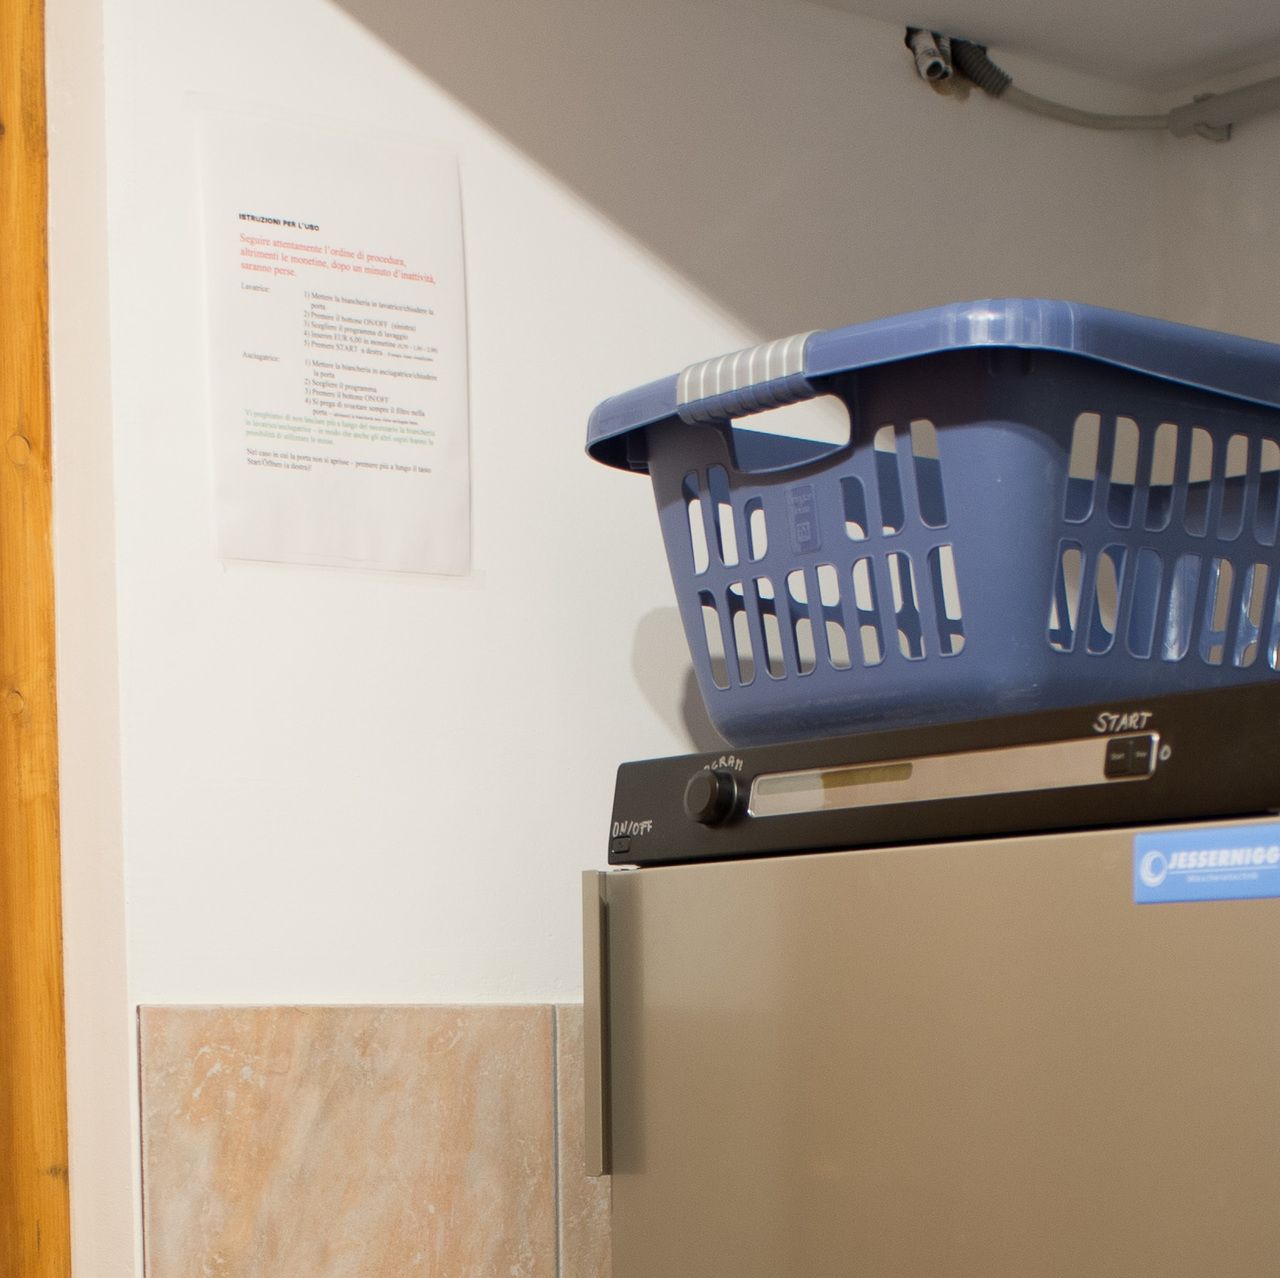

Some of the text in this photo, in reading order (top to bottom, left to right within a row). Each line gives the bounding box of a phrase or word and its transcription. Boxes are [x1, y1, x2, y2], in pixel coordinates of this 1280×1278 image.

[238, 213, 319, 231] ISTRUZIONI PER L'USO
[239, 232, 270, 247] Seguire
[272, 238, 321, 253] attentamente
[356, 249, 364, 258] di
[240, 246, 279, 261] altrimenti
[281, 252, 288, 261] le
[330, 260, 350, 273] dopo
[364, 265, 391, 277] minuto
[240, 261, 272, 273] saranno
[1092, 711, 1153, 733] START
[612, 819, 653, 837] ON/OFF
[1167, 844, 1280, 870] JESSERNIGG
